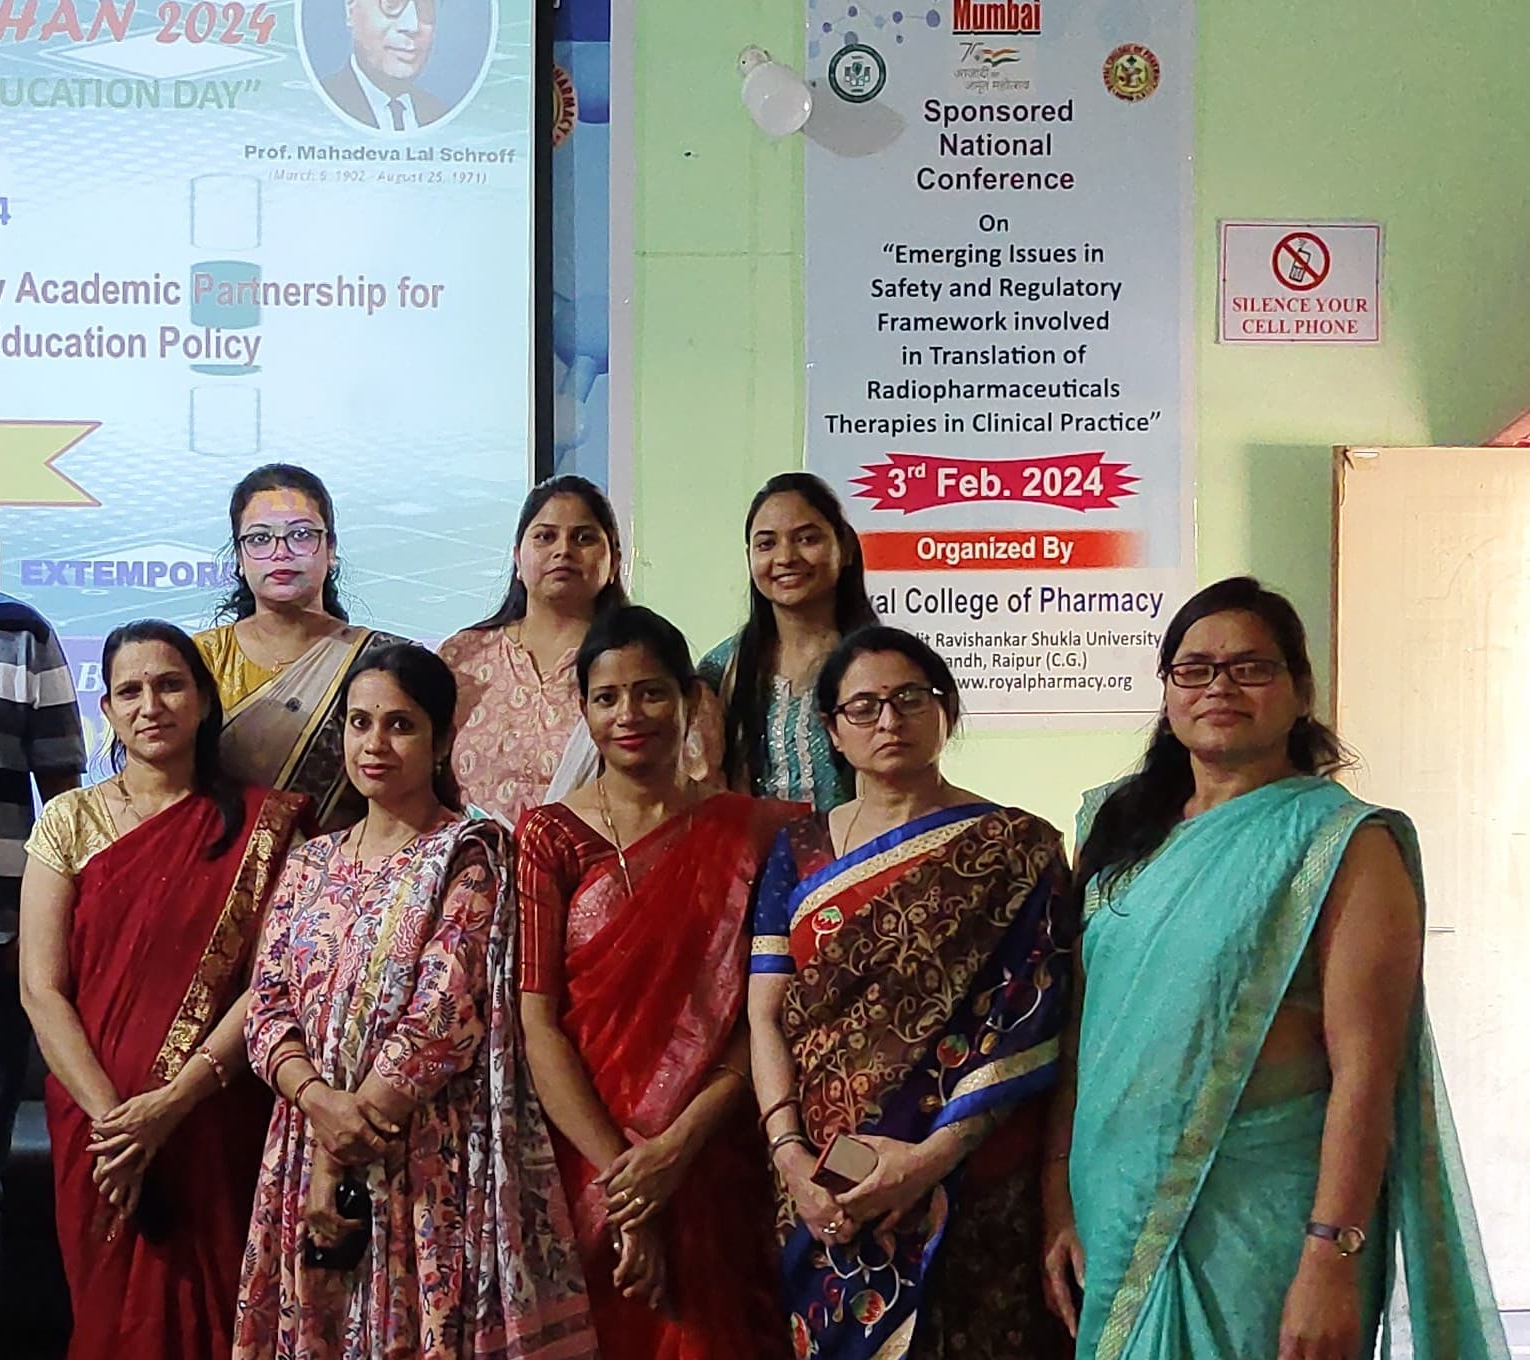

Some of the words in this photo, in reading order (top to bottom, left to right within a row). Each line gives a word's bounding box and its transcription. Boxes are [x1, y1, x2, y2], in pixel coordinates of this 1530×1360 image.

[156, 0, 277, 44] 2024
[174, 79, 262, 110] DAY”
[553, 64, 576, 136] HARMACY
[924, 100, 1073, 128] Sponsored
[244, 145, 292, 160] Prof.
[298, 145, 400, 161] Mahadeva
[406, 147, 434, 162] Lal
[440, 148, 516, 163] Schroff
[940, 134, 1052, 156] National
[917, 168, 1075, 191] Conference
[979, 215, 1009, 232] On
[883, 243, 1002, 268] “Emerging
[1009, 245, 1077, 264] Issues
[1084, 243, 1104, 263] in
[15, 272, 181, 305] Academic
[194, 273, 387, 315] Partnership
[398, 276, 445, 310] for
[871, 279, 943, 303] Safety
[949, 278, 991, 298] and
[999, 278, 1122, 302] Regulatory
[1232, 297, 1311, 313] SILENCE
[1316, 298, 1368, 313] YOUR
[878, 311, 1007, 332] Framework
[1013, 311, 1110, 332] involved
[1242, 319, 1291, 334] CELL
[1295, 319, 1358, 334] PHONE
[160, 325, 262, 367] Policy
[901, 345, 922, 365] in
[929, 345, 1056, 365] Translation
[1063, 344, 1087, 364] of
[867, 378, 1120, 402] Radiopharmaceuticals
[825, 413, 937, 437] Therapies
[944, 413, 964, 433] in
[972, 412, 1052, 433] Clinical
[1061, 411, 1162, 432] Practice”
[887, 462, 926, 498] 3rd
[937, 467, 1011, 498] Feb.
[1022, 466, 1104, 498] 2024
[917, 536, 1037, 565] Organized
[1043, 536, 1074, 565] By
[905, 587, 999, 619] College
[1007, 587, 1032, 614] of
[1040, 587, 1164, 619] Pharmacy
[935, 631, 1028, 648] Ravishankar
[1031, 631, 1082, 648] Shukla
[1086, 631, 1162, 649] University
[992, 652, 1042, 671] Raipur
[1046, 652, 1088, 671] (C.G.)
[957, 673, 1132, 692] ww.royalpharmacy.org
